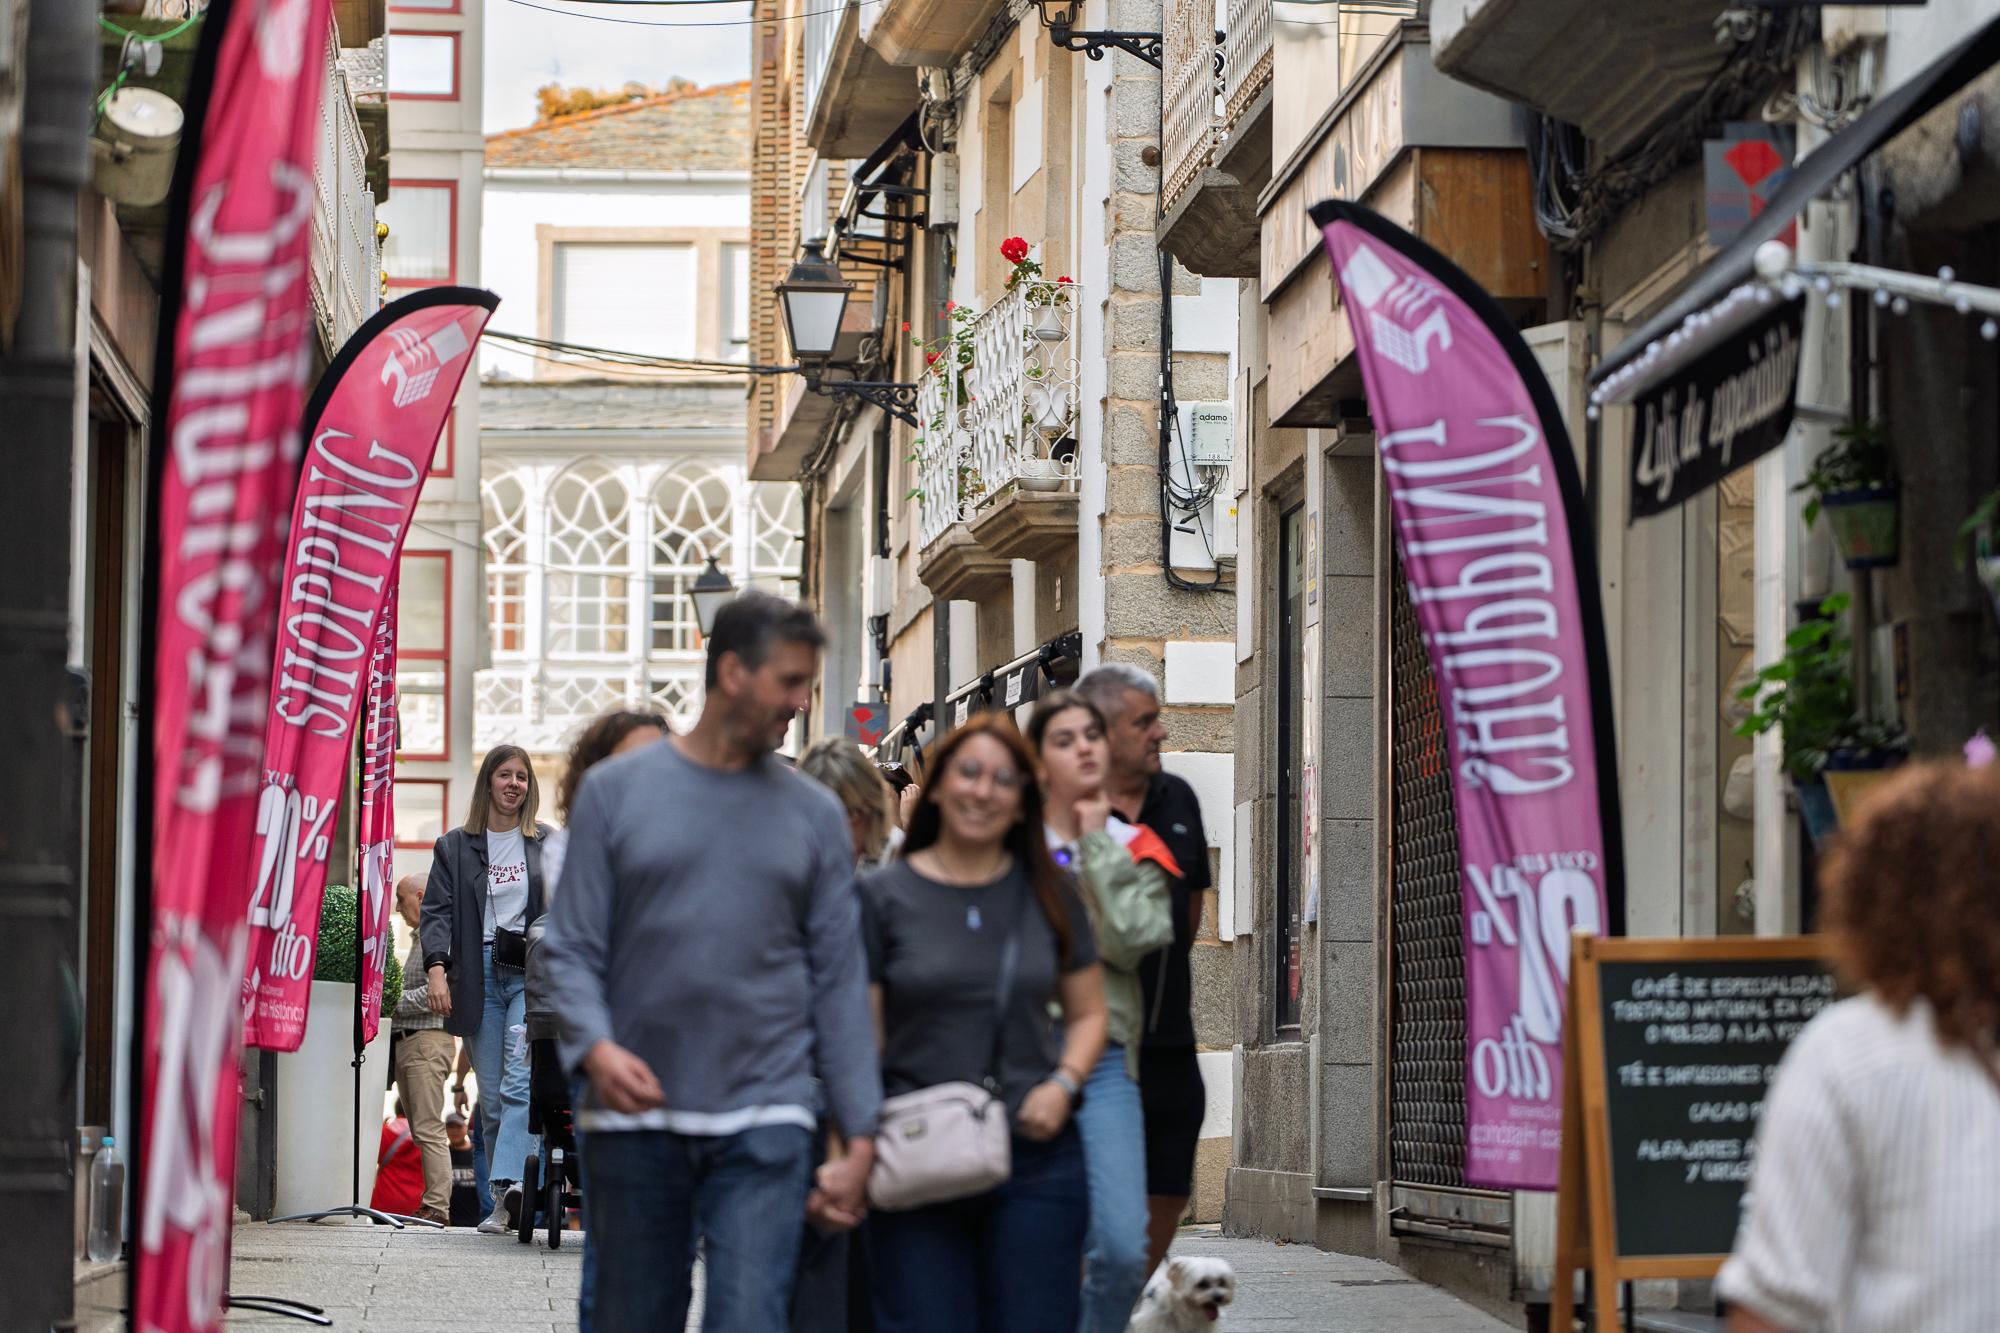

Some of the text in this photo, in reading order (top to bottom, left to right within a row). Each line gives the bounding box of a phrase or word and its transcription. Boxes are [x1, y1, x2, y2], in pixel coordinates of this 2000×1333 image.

[1199, 413, 1227, 421] adamo
[274, 426, 420, 740] SHOPPING
[488, 870, 506, 878] OOD
[495, 875, 521, 885] L.A.
[270, 922, 312, 981] dto
[1632, 972, 1680, 998] CAFÉ
[1683, 977, 1709, 998] DE
[1726, 1022, 1743, 1043] A
[1745, 1022, 1773, 1043] LA
[1689, 1101, 1749, 1123] CACAO
